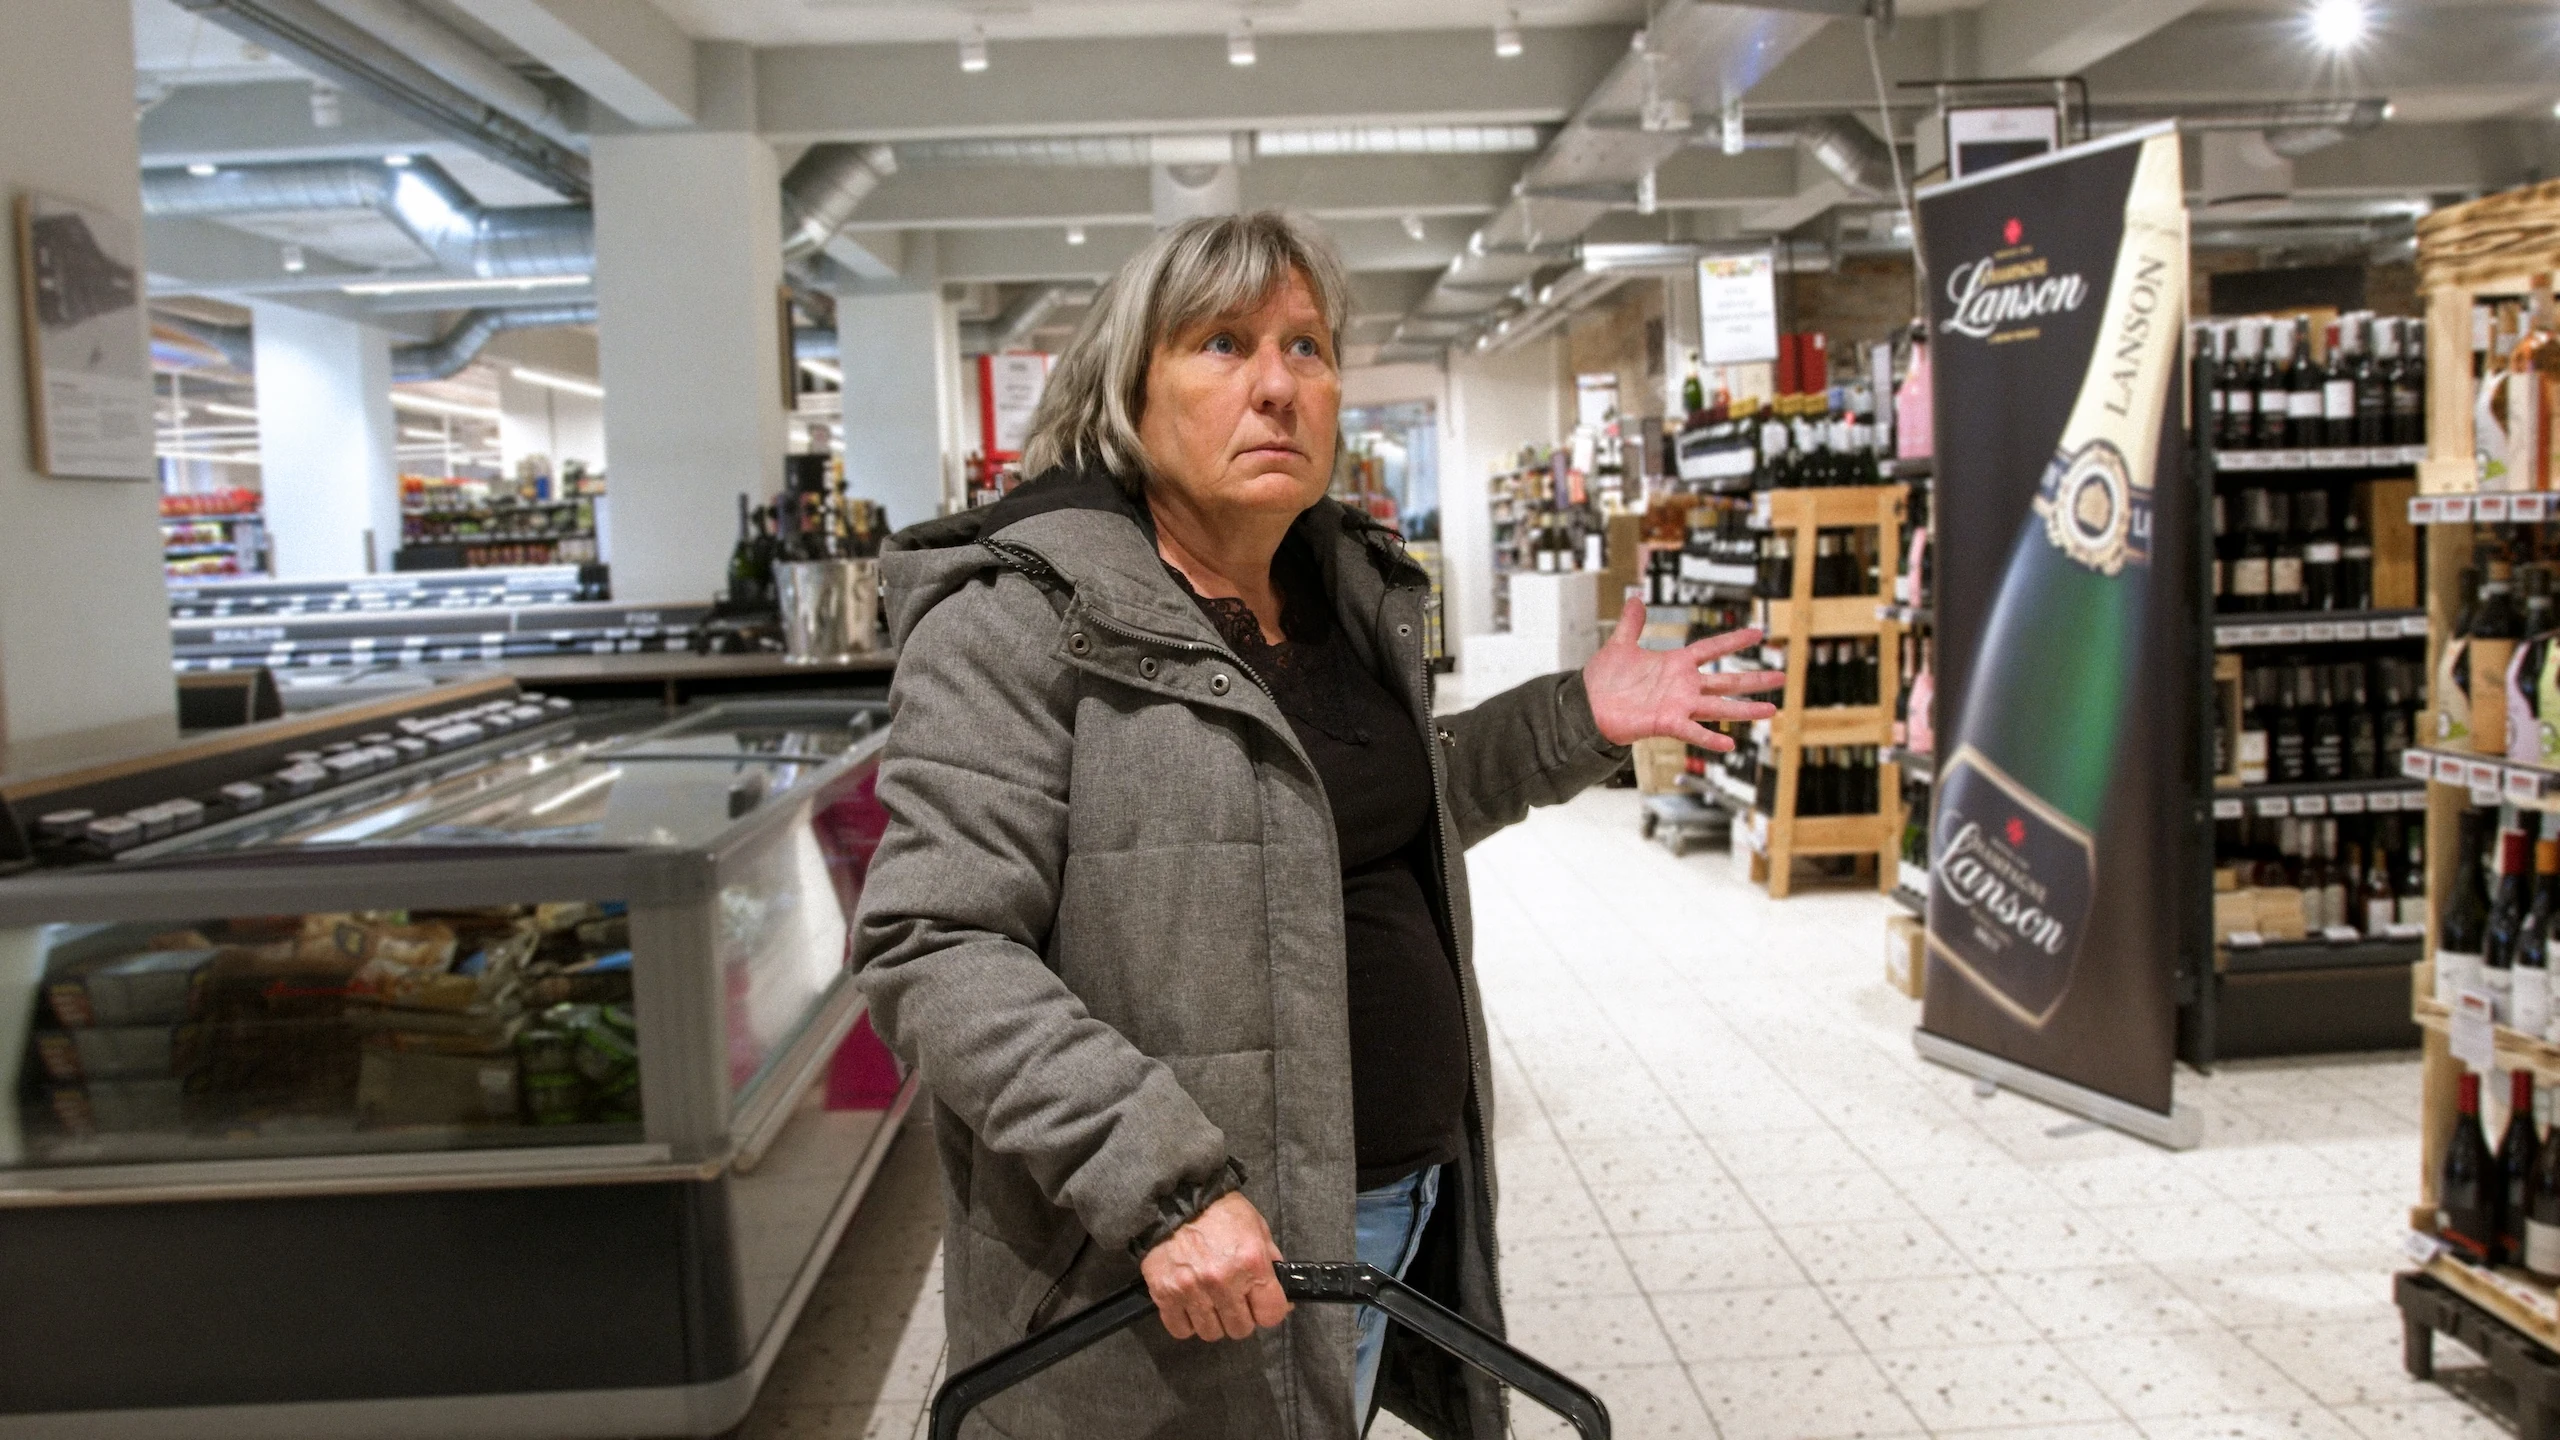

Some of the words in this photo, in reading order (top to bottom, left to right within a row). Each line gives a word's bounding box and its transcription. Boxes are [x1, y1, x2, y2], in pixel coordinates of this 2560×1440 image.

[1940, 257, 2088, 337] Lanson
[2104, 255, 2166, 416] LANSON
[1936, 808, 2067, 955] Lanson
